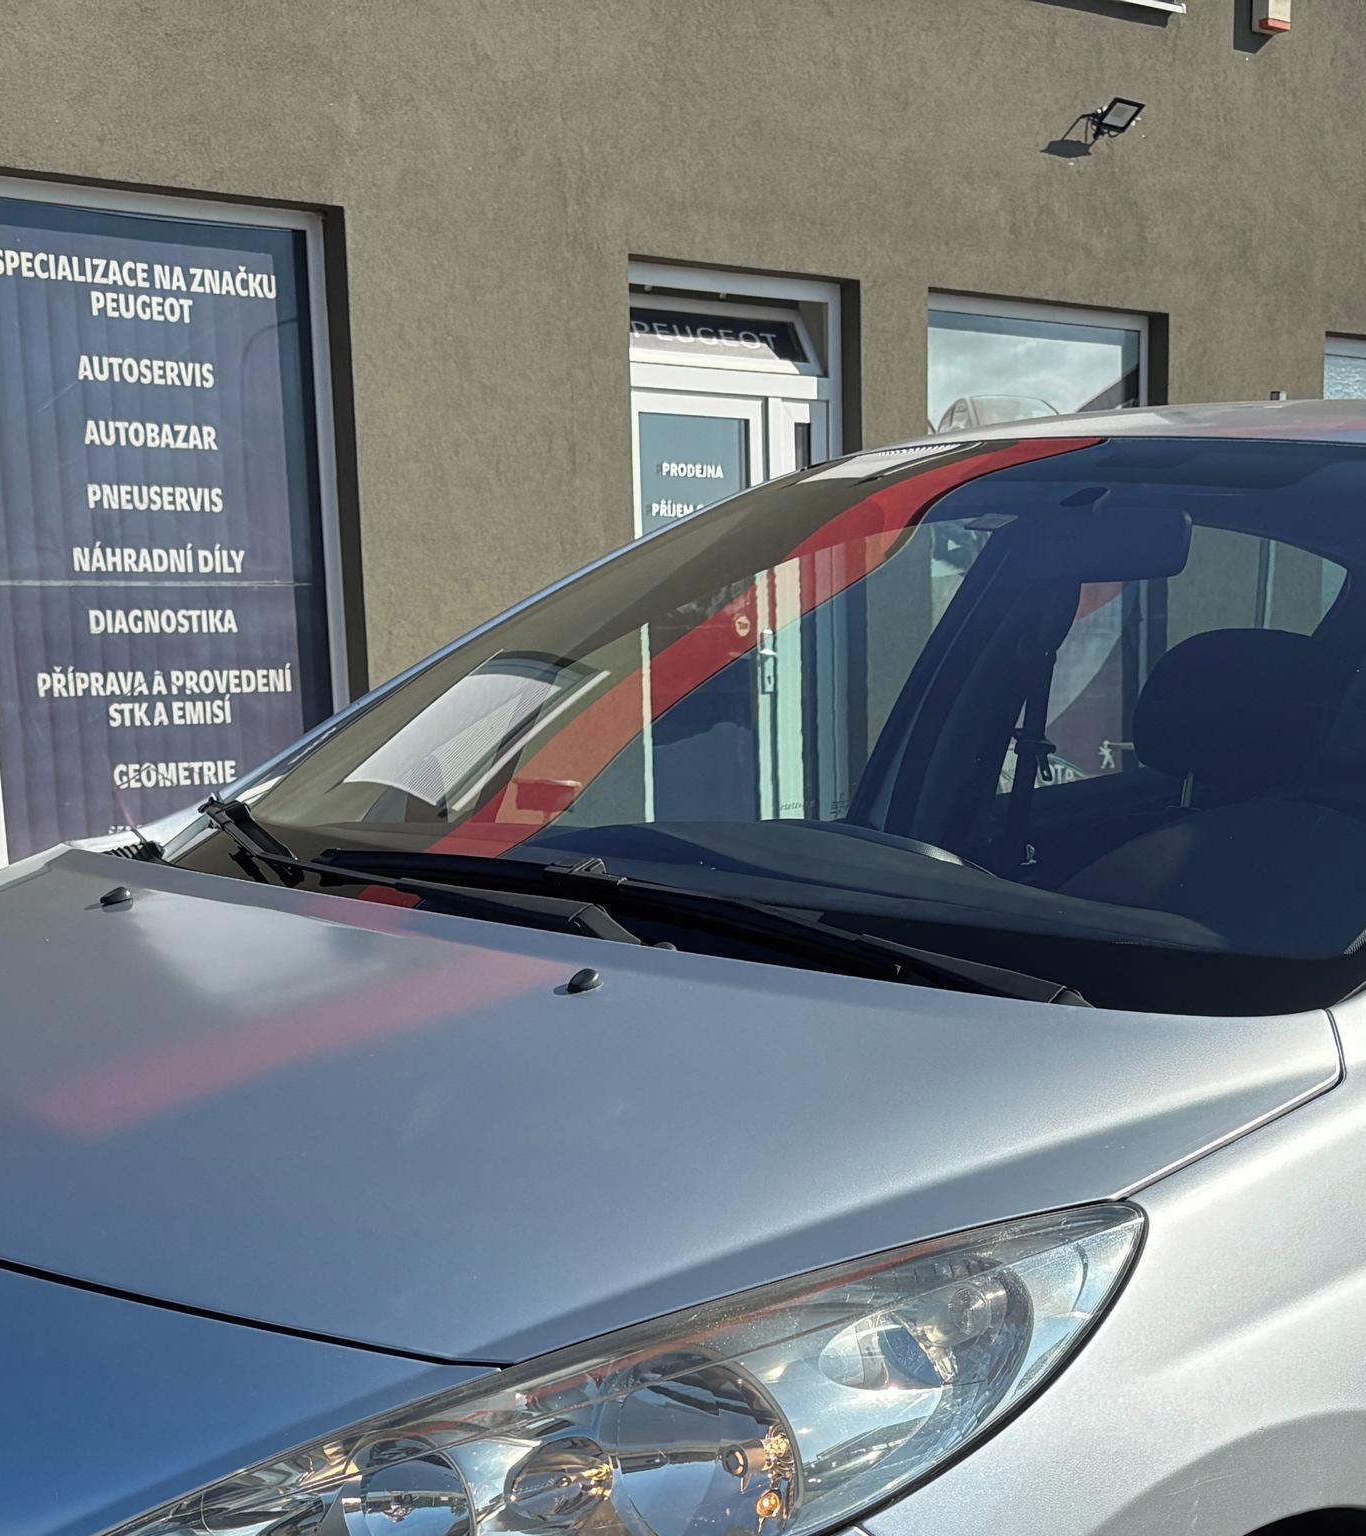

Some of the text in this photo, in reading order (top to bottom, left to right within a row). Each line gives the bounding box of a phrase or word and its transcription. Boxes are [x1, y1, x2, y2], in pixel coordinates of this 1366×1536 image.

[154, 264, 187, 291] NA
[190, 265, 277, 299] ZNAČKU
[90, 290, 193, 324] PEUGEOT
[78, 355, 215, 388] AUTOSERVIS
[84, 420, 218, 450] AUTOBAZAR
[661, 462, 724, 478] PRODEJNA
[87, 483, 224, 513] PNEUSERVIS
[72, 541, 246, 574] NÁHRADNÍ DÍLY
[88, 608, 238, 634] DIAGNOSTIKA
[37, 663, 293, 697] PŘÍPRAVA A PROVEDENÍ
[108, 695, 232, 728] STK A EMISÍ
[113, 760, 238, 790] GEOMETRIE
